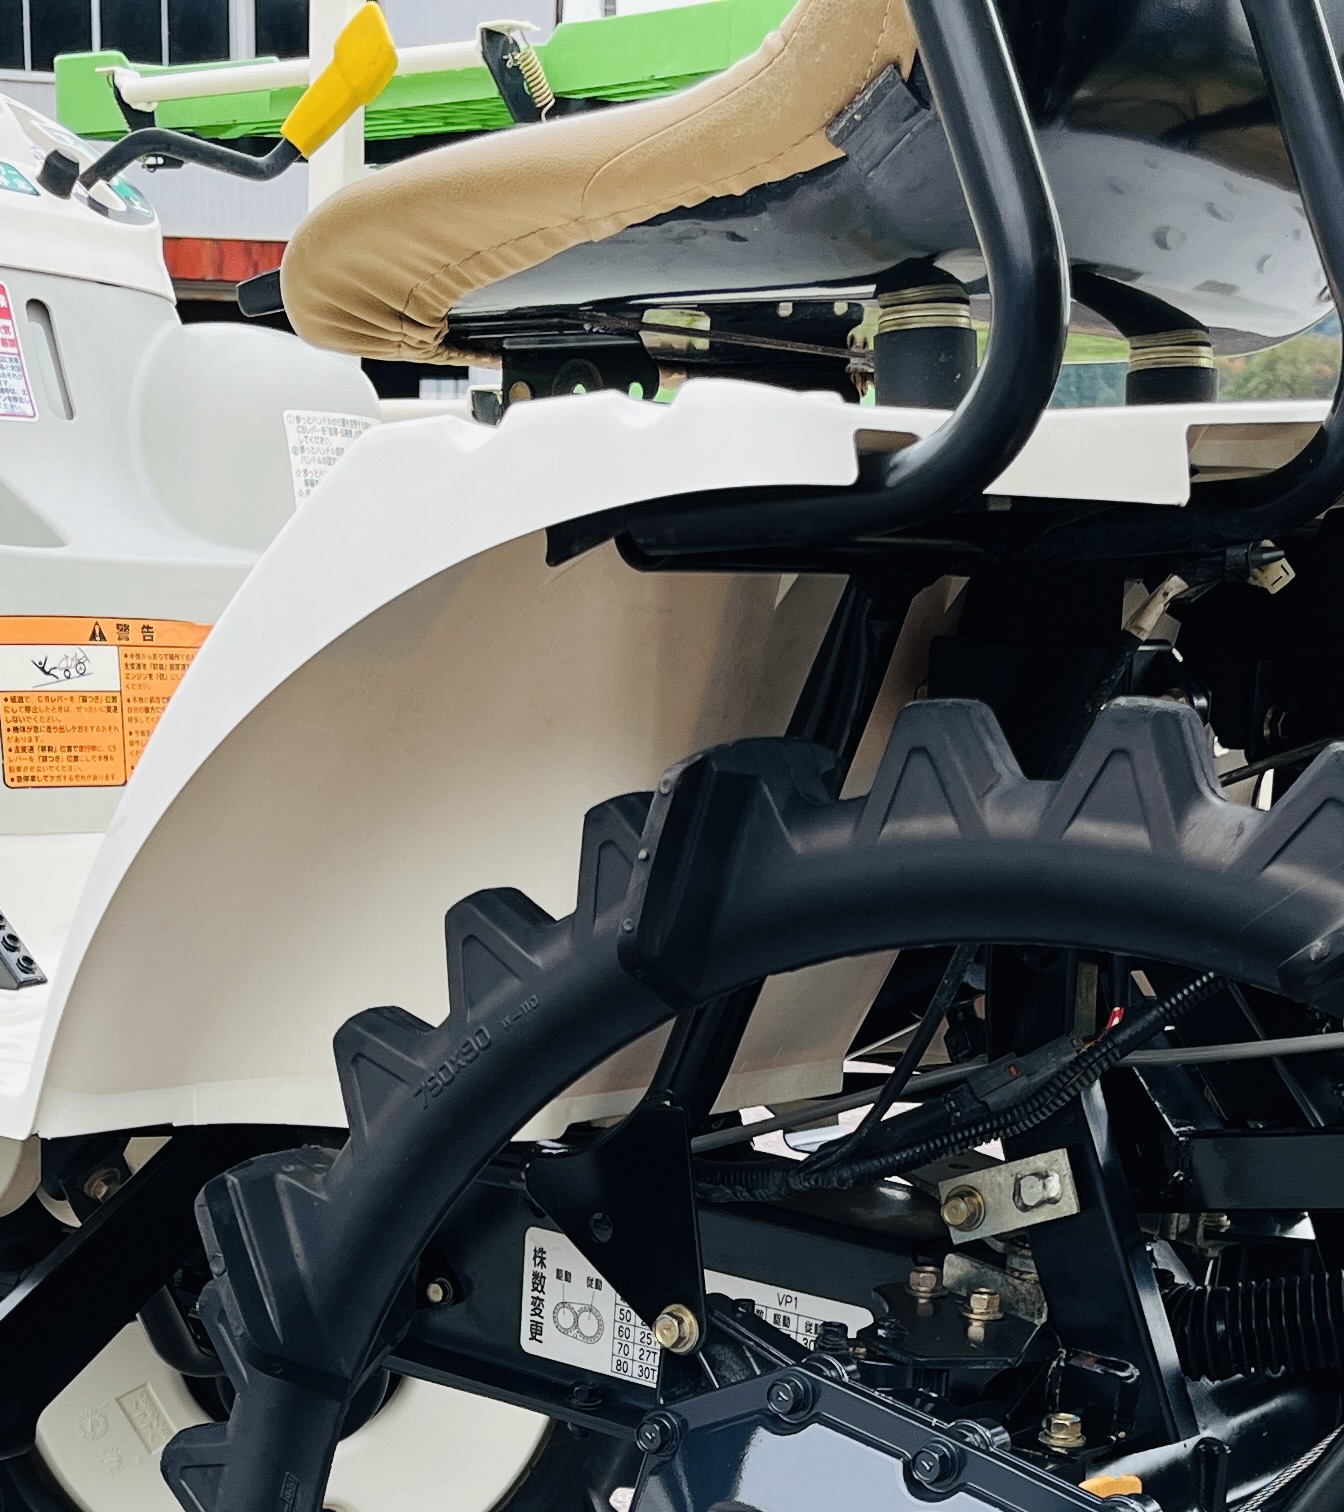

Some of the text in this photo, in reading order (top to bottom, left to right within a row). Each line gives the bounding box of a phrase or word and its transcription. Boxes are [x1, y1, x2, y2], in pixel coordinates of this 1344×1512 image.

[115, 623, 155, 643] 警告
[586, 1276, 603, 1291] 従動
[529, 1246, 547, 1343] 株数変更
[777, 1292, 798, 1310] VP1
[619, 1310, 631, 1323] 50
[618, 1326, 630, 1340] 60
[618, 1342, 630, 1356] 70
[639, 1349, 658, 1363] 27T
[615, 1360, 628, 1373] 80
[637, 1366, 657, 1381] 30T
